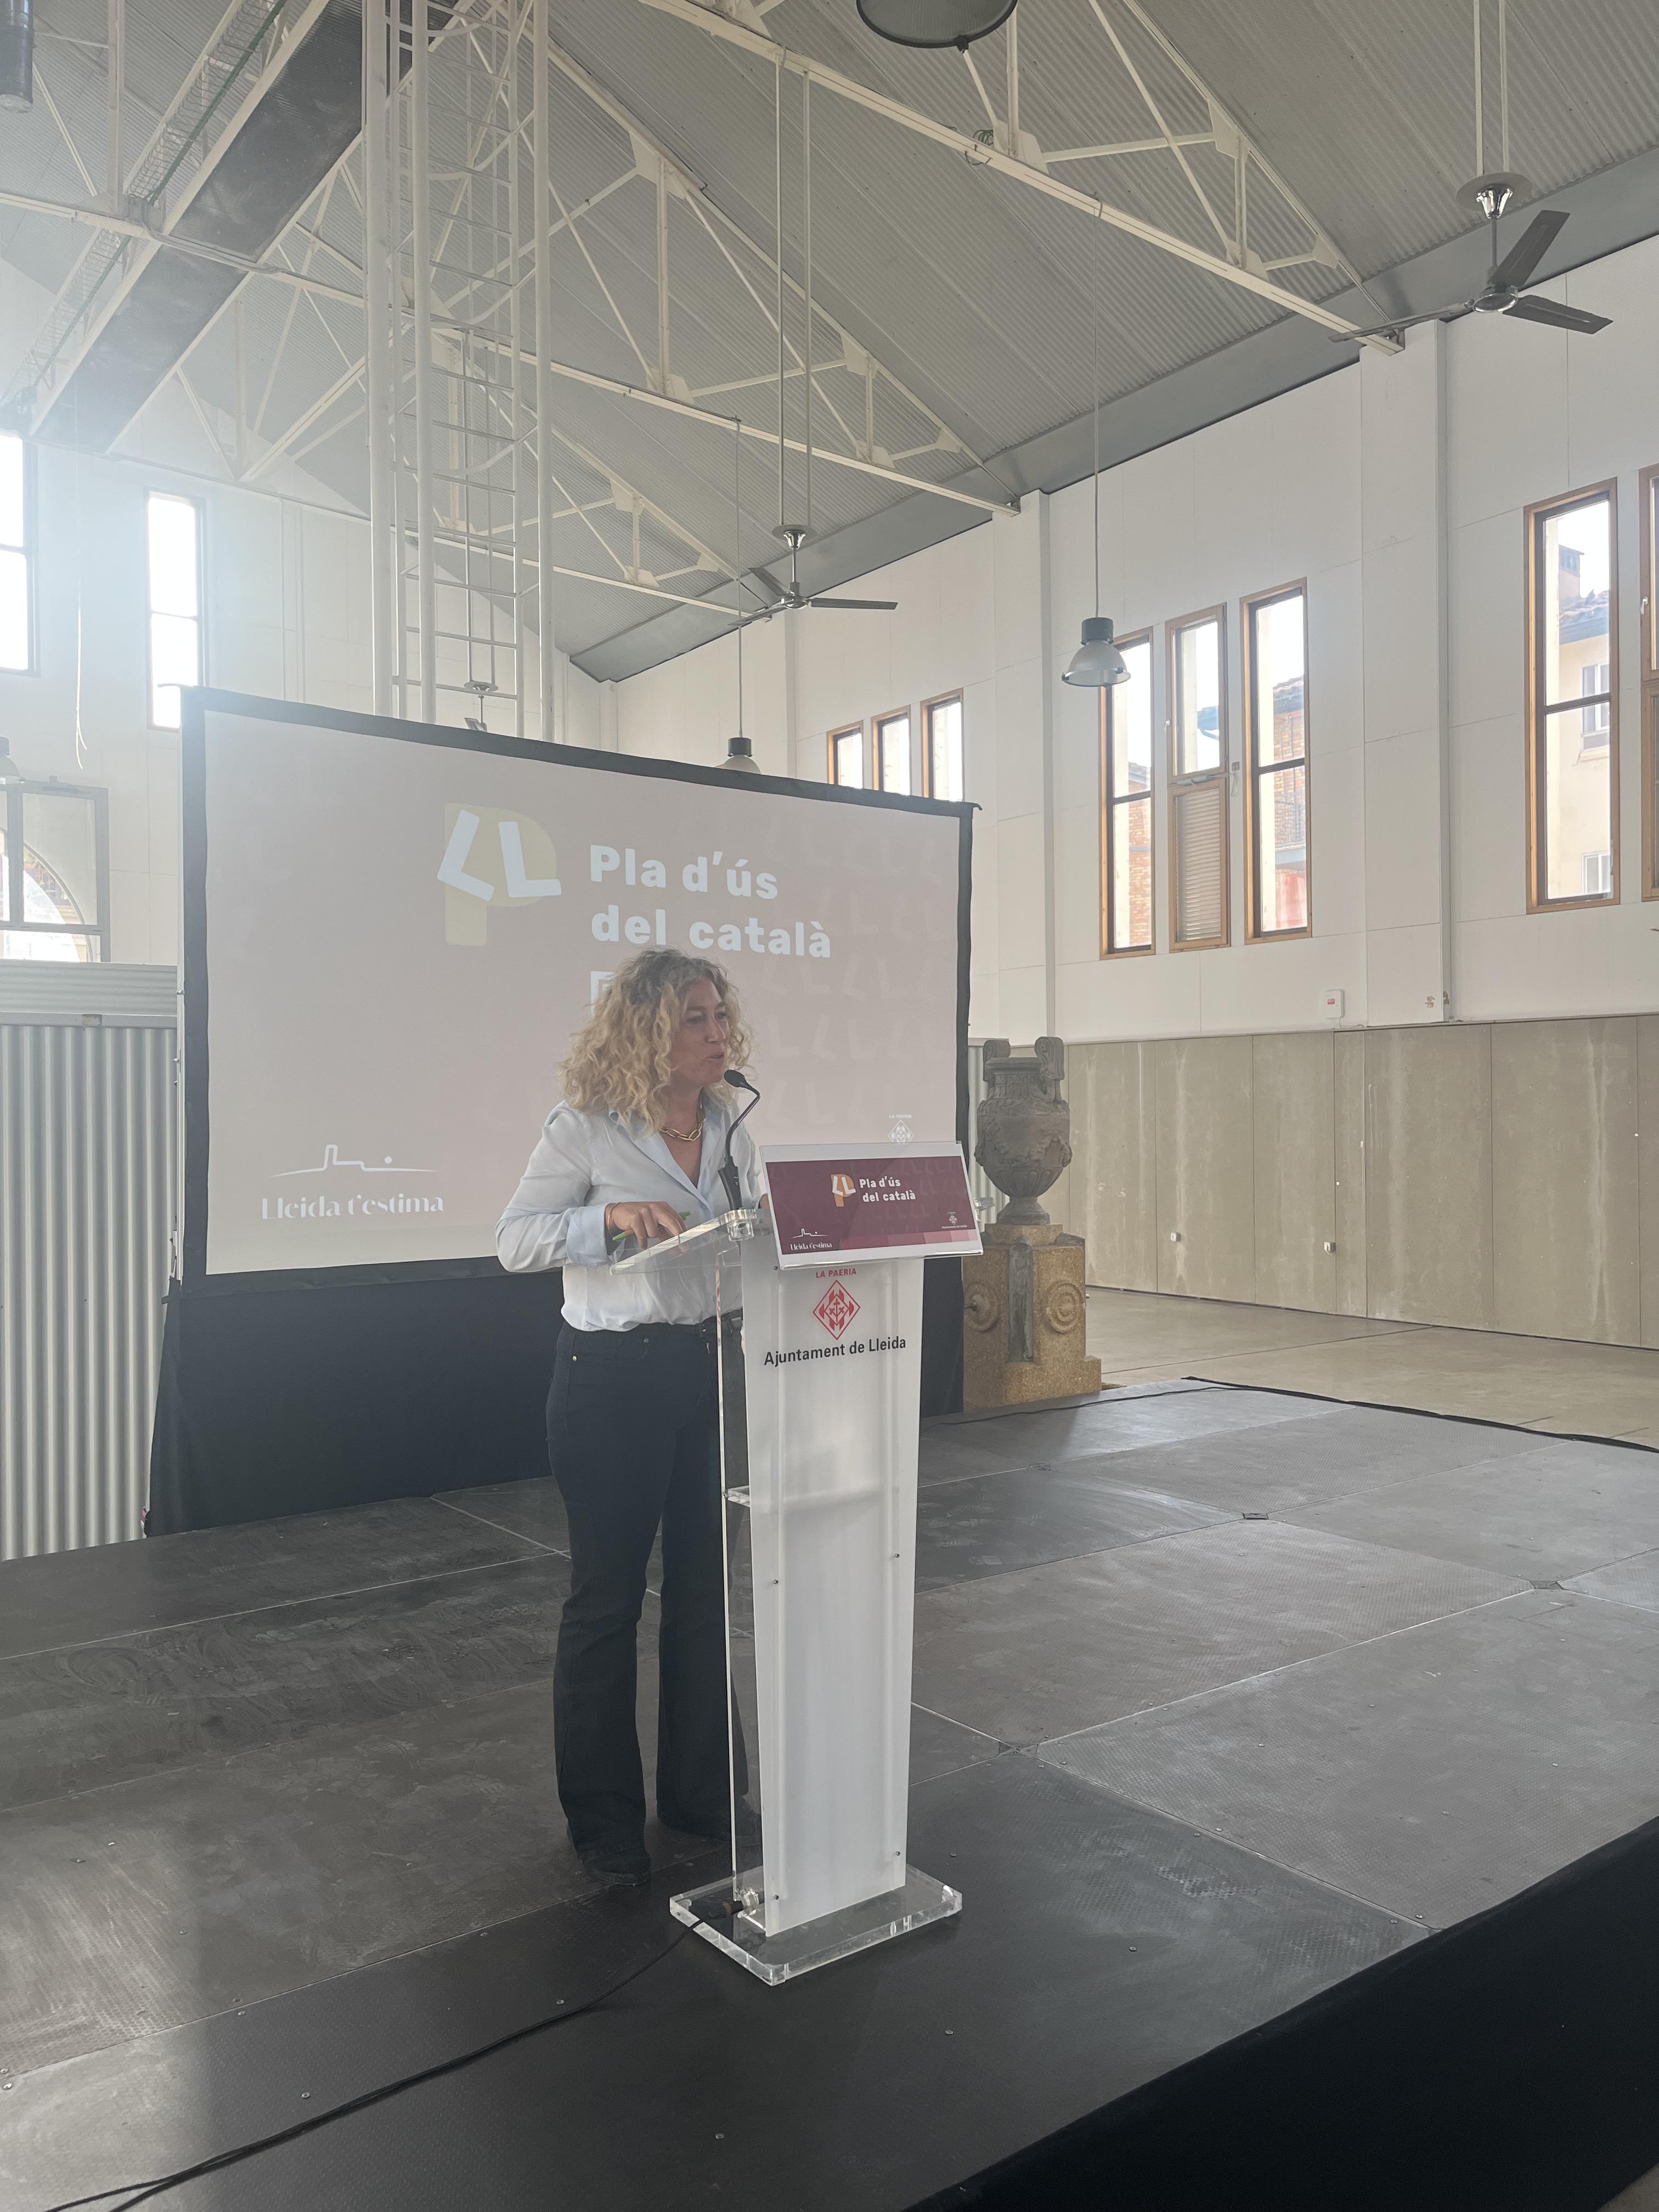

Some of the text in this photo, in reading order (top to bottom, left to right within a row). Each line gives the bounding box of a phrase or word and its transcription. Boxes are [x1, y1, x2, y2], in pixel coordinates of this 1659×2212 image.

[590, 844, 778, 900] Pla d'ús
[591, 904, 831, 958] del català
[859, 1176, 901, 1188] Pla d'ús
[862, 1189, 916, 1202] del català
[262, 1193, 444, 1220] Lleida t'estima
[790, 1242, 809, 1250] Lleida
[828, 1268, 857, 1277] PAERIA
[764, 1336, 906, 1367] Ajuntament de Lleida
